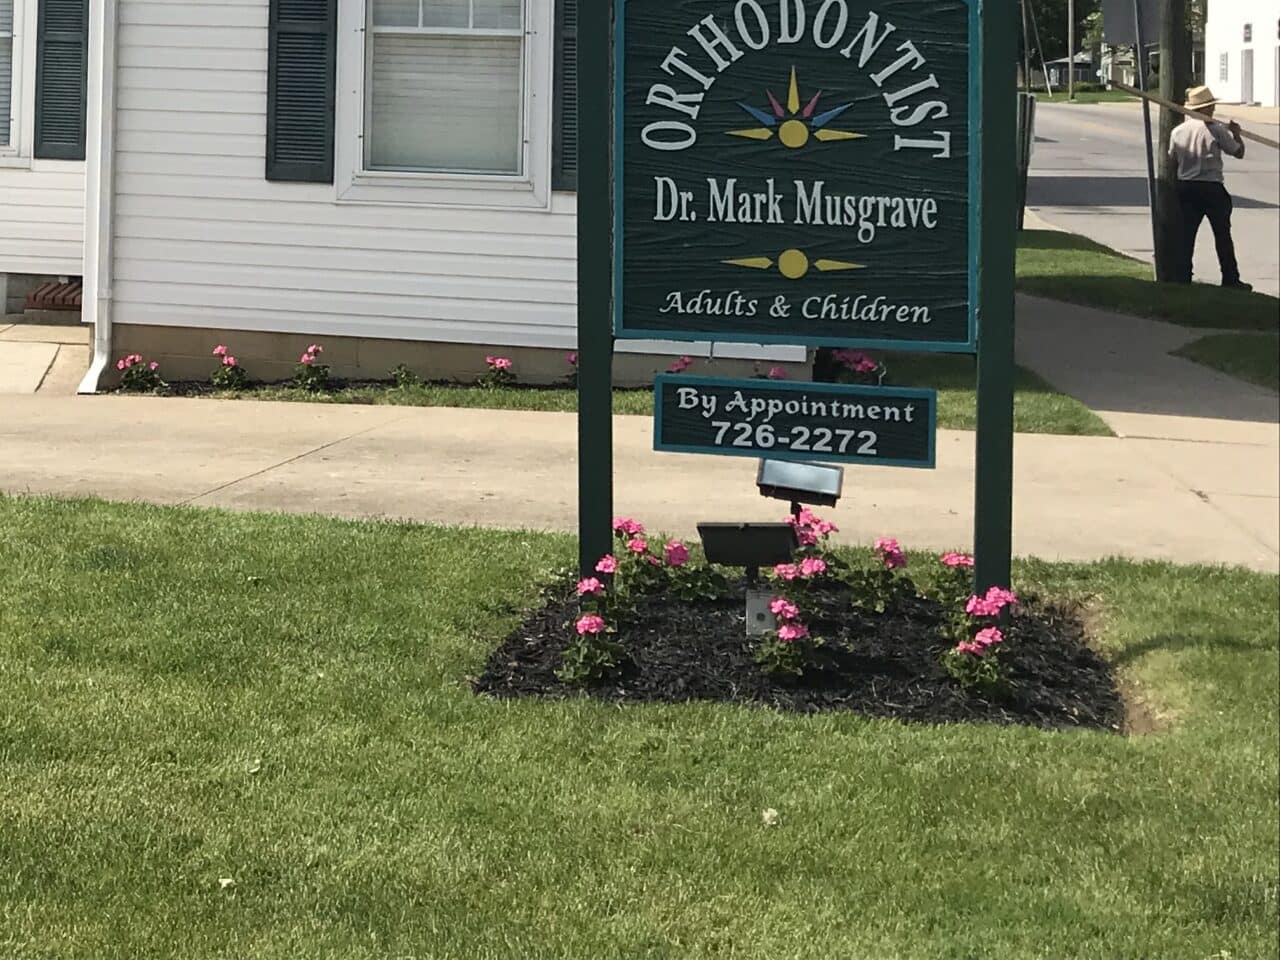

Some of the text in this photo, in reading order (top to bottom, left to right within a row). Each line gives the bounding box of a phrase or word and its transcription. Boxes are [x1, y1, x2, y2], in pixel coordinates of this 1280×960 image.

[653, 176, 938, 243] Dr. Mark Musgrave
[658, 290, 932, 324] Adults & Children
[676, 387, 915, 423] By Appointment
[711, 421, 878, 455] 726-2272
